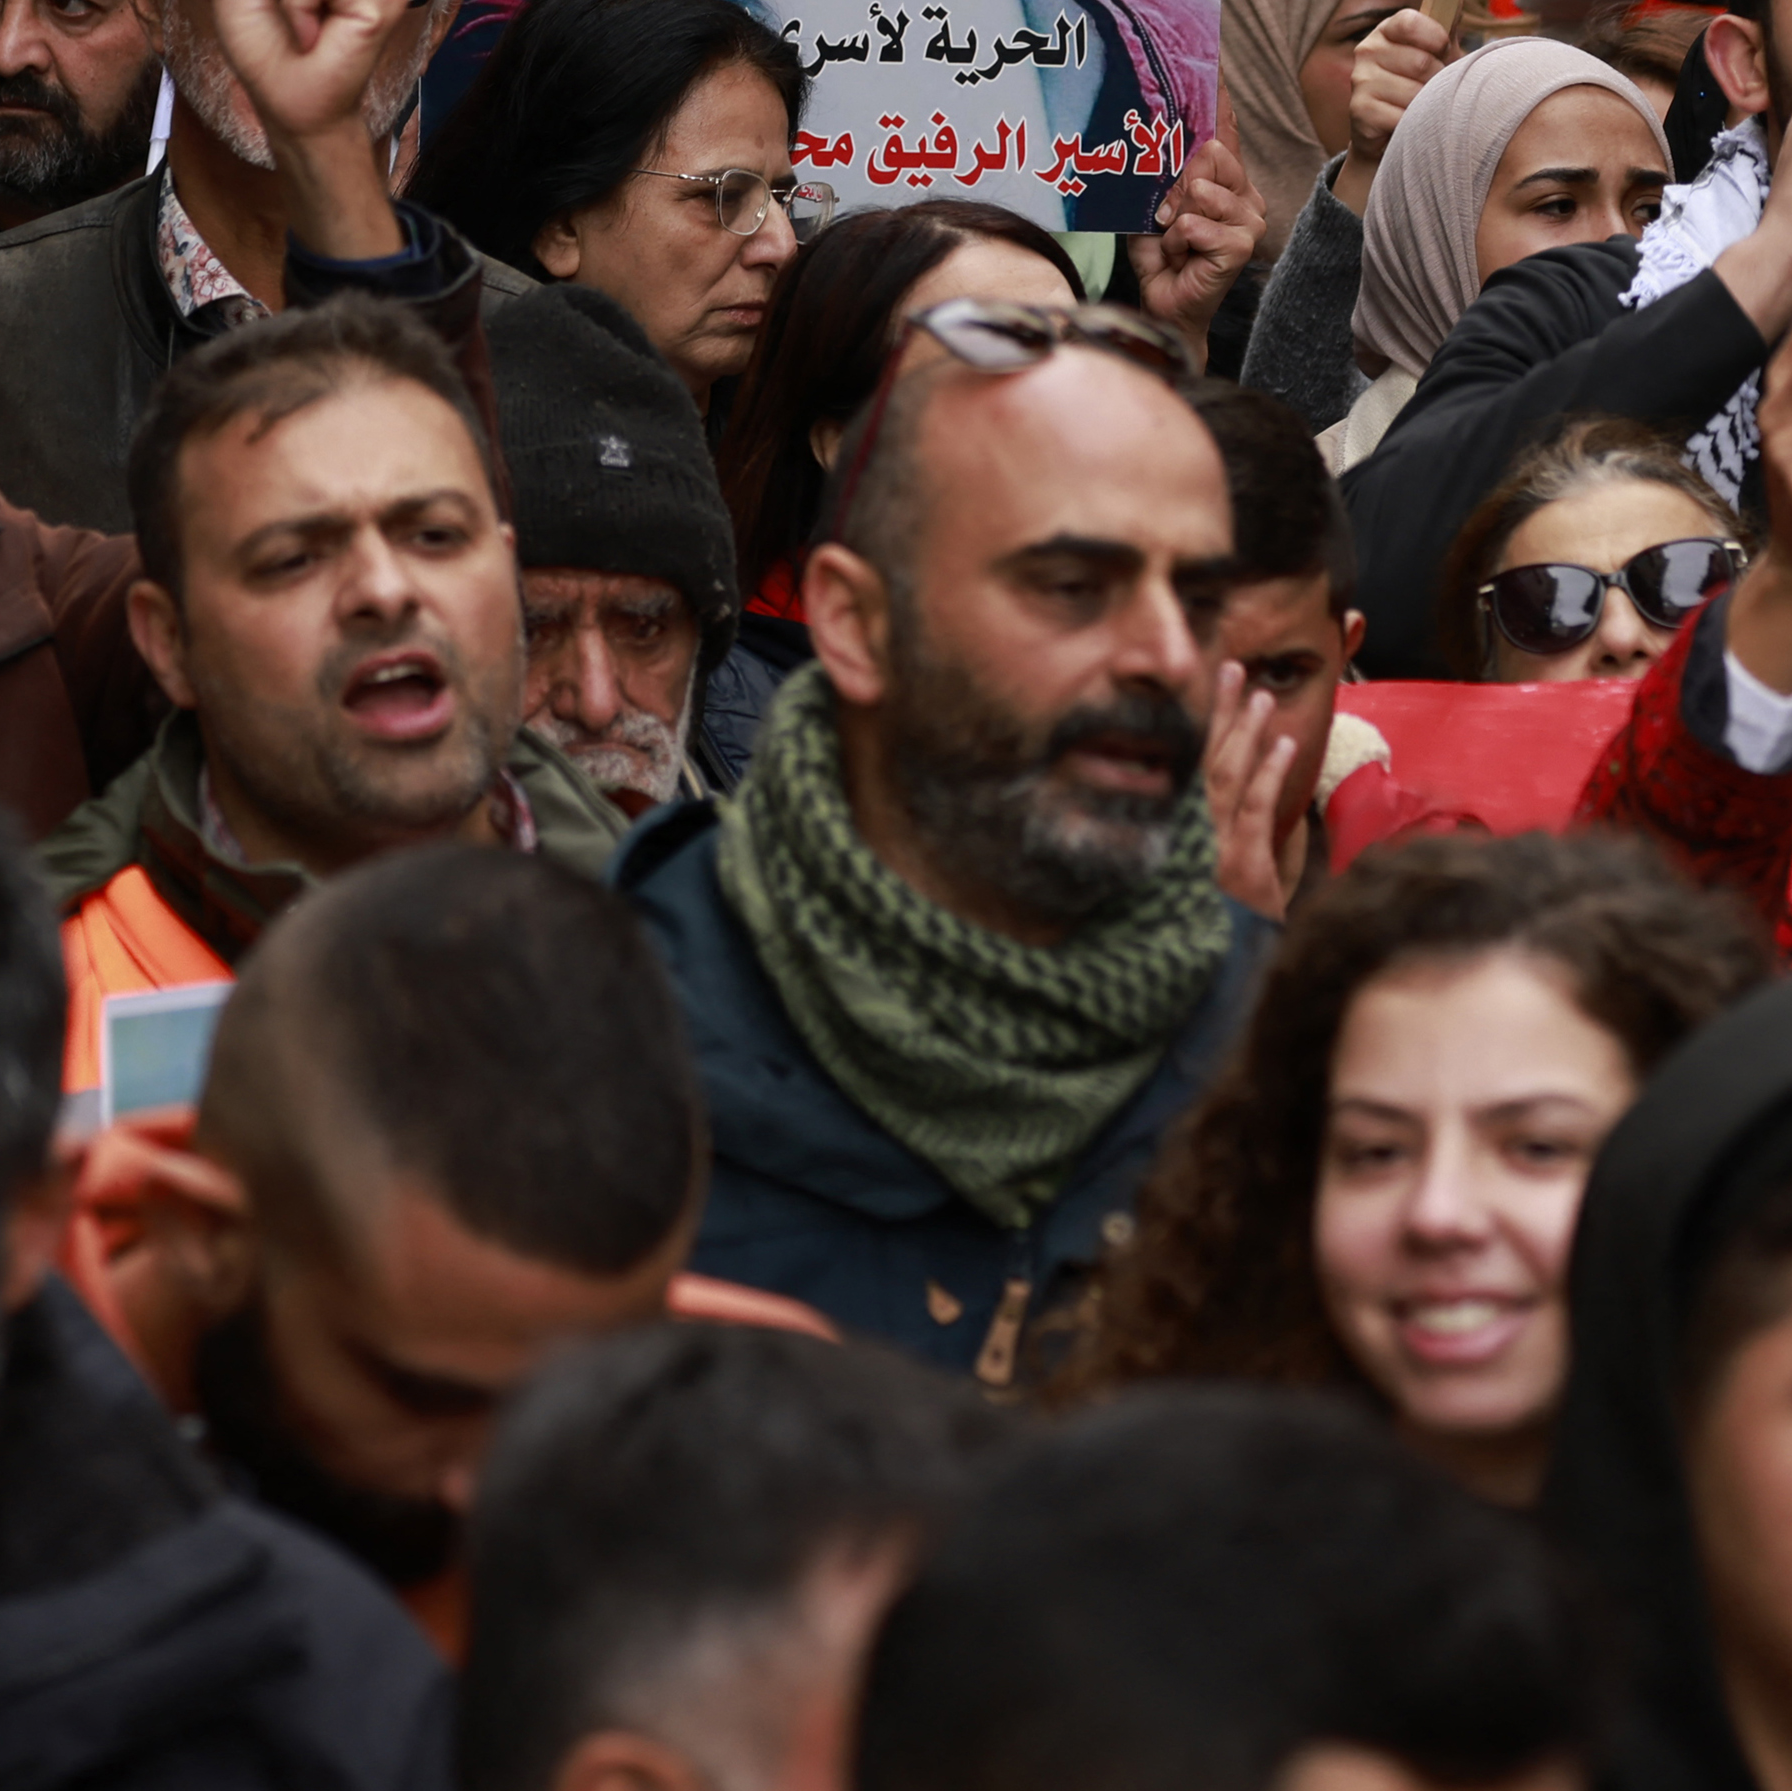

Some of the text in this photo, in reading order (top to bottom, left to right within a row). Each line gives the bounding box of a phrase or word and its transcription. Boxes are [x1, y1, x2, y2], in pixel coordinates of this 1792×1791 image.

[920, 4, 1088, 85] الحرية
[789, 108, 1185, 196] الأسير الرفيق مح
